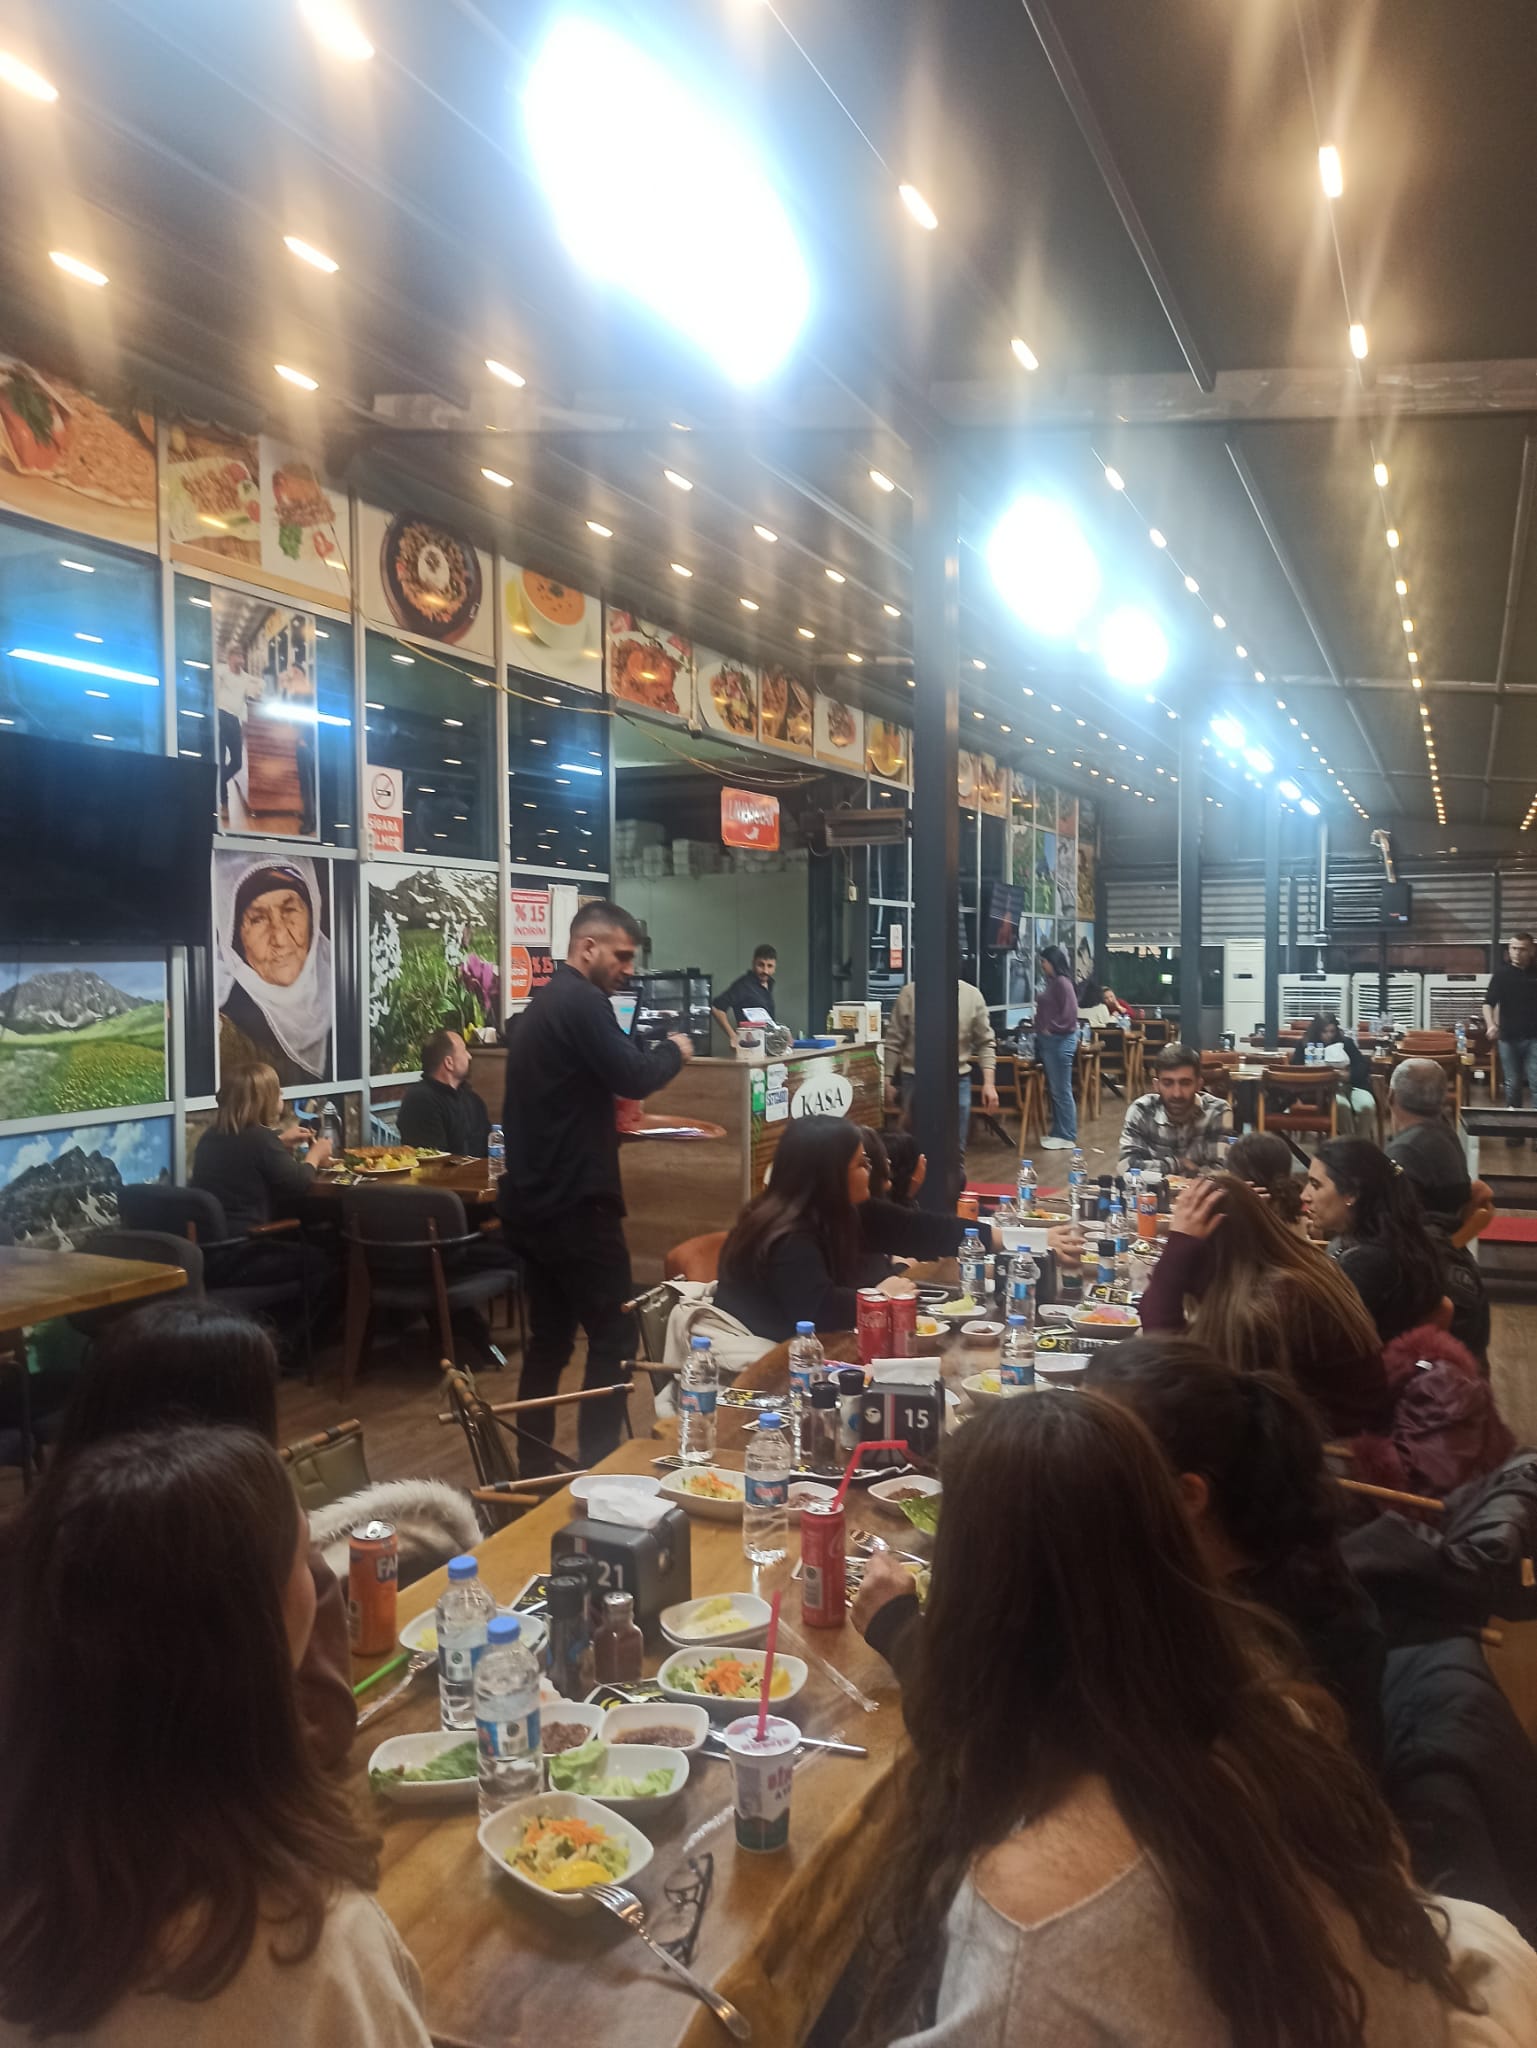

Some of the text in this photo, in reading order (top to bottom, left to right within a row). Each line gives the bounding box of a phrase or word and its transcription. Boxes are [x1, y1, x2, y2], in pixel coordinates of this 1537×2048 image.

[530, 906, 545, 922] 15
[801, 1087, 844, 1116] KASA
[905, 1408, 929, 1429] 15
[597, 1560, 624, 1590] 21
